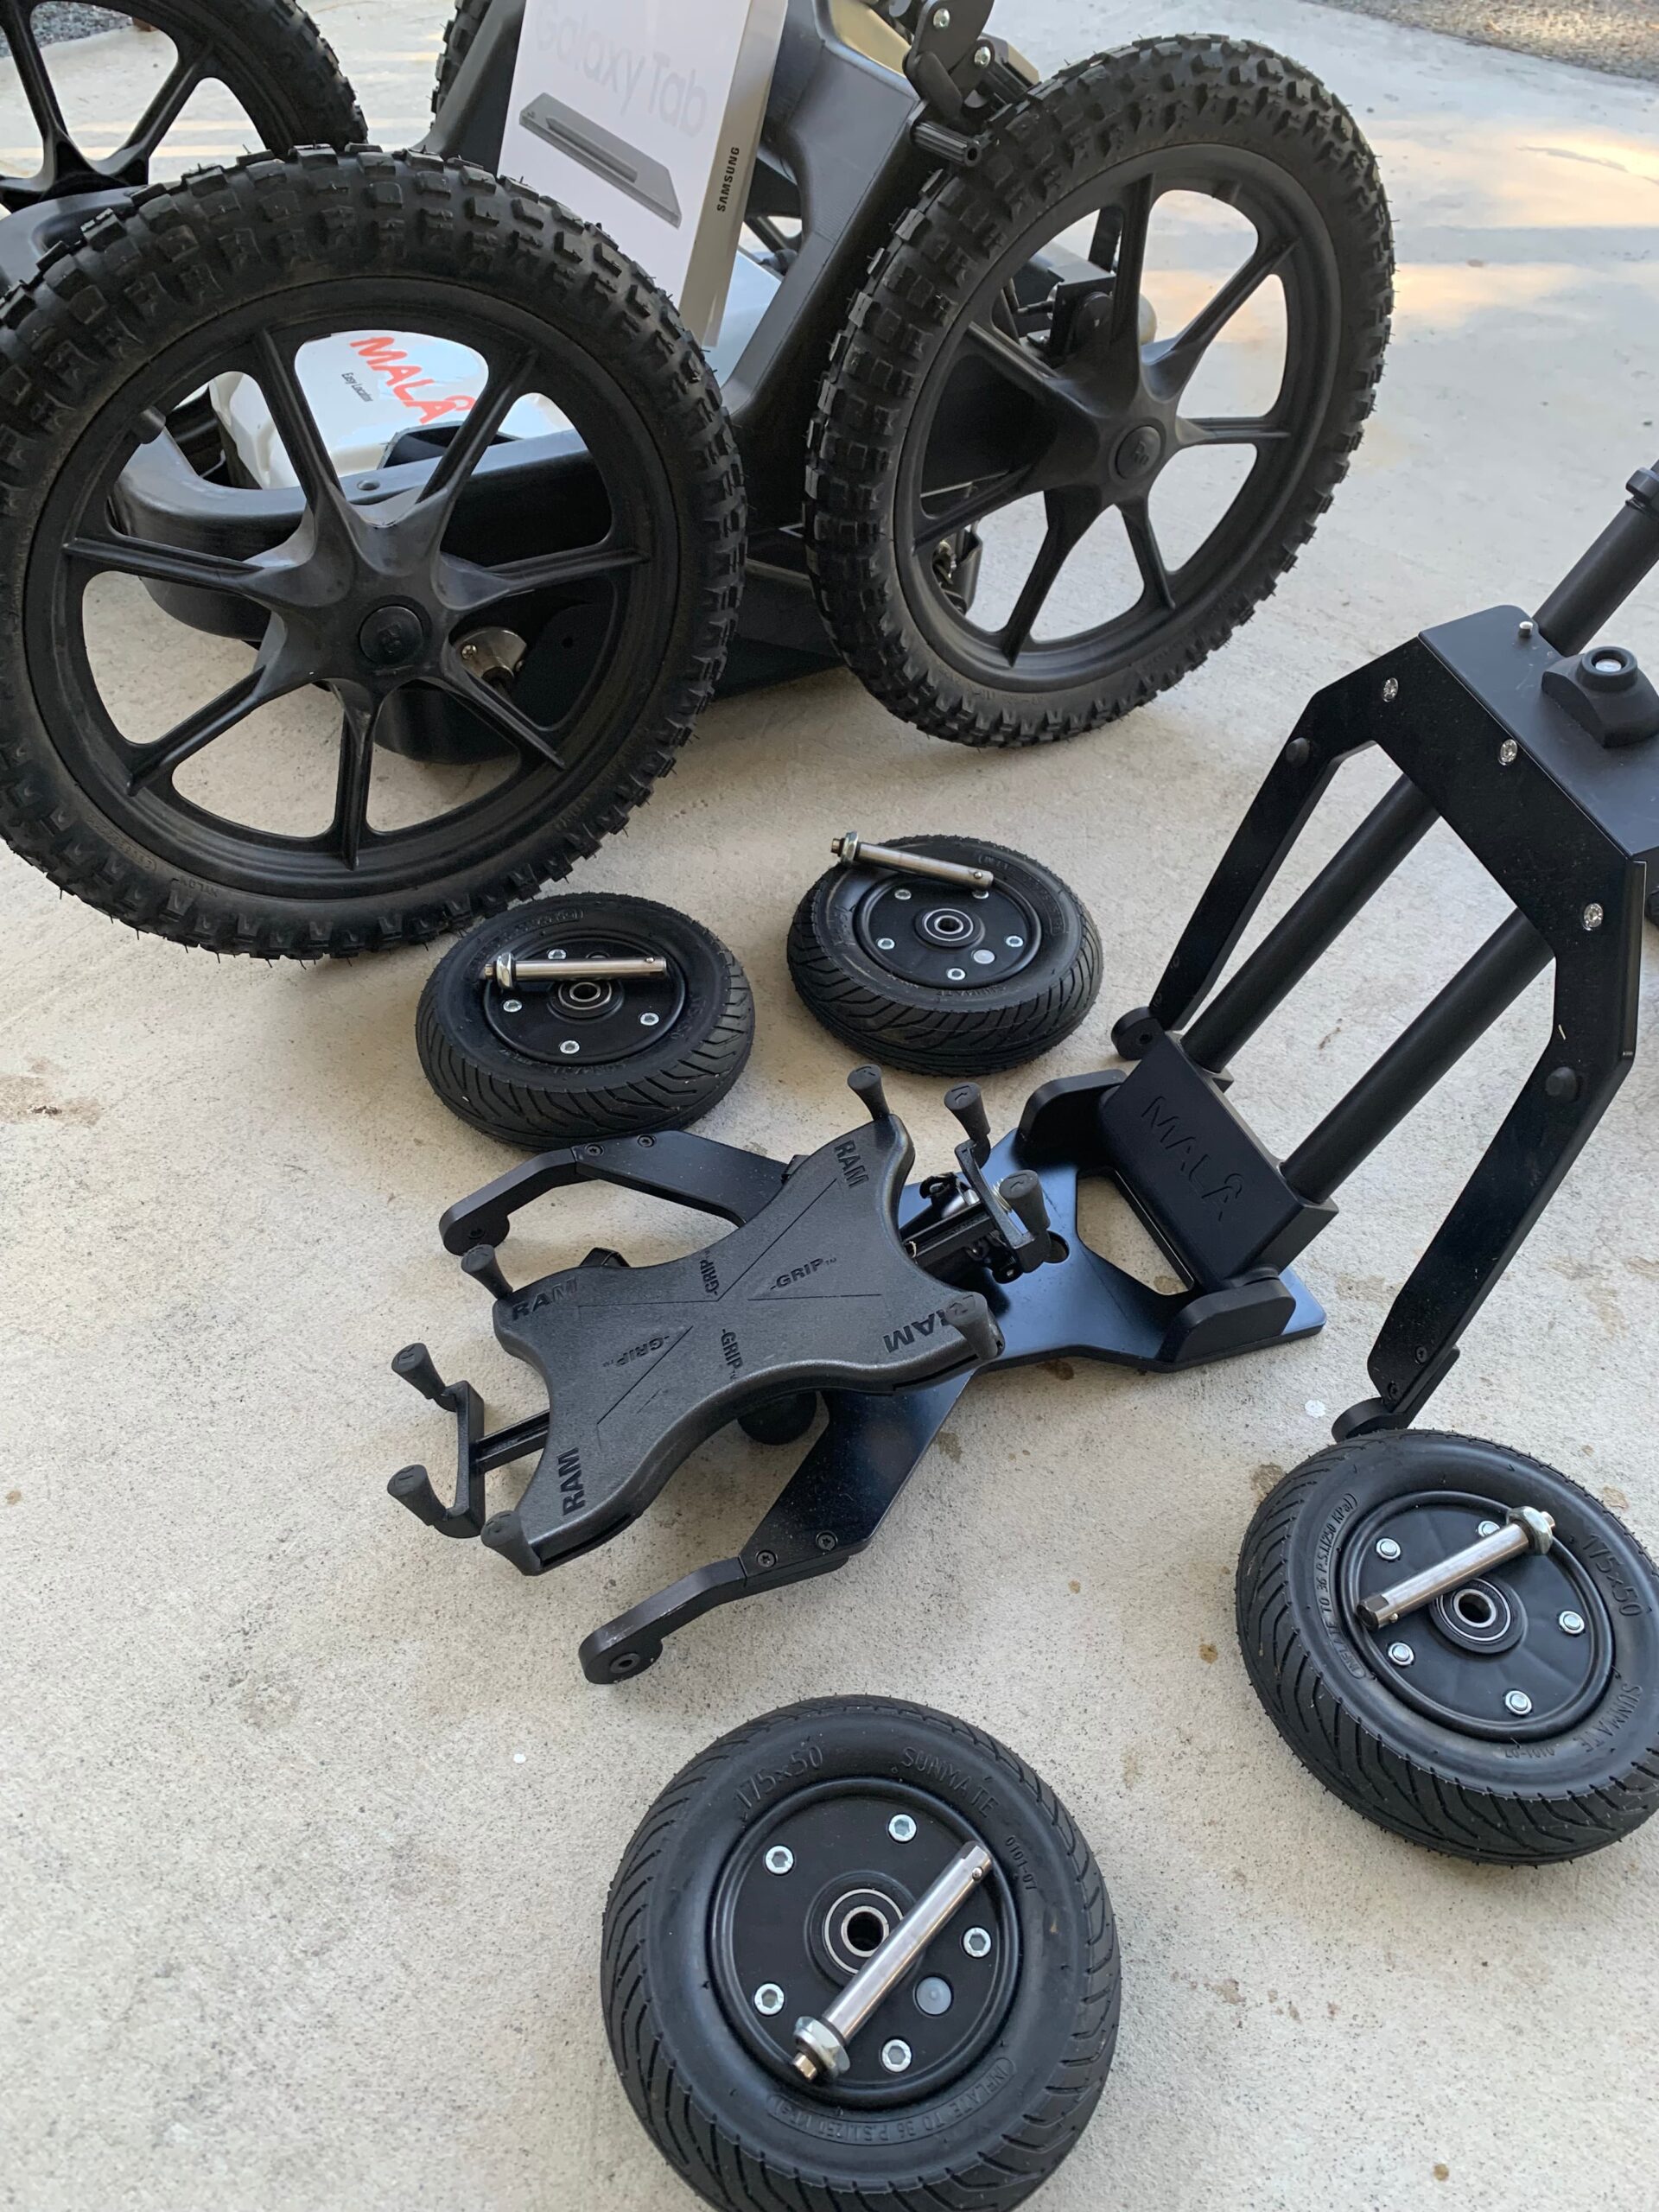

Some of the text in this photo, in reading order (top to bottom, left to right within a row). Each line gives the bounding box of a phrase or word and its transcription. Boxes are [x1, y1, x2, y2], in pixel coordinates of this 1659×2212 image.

[648, 51, 708, 137] Tab
[716, 146, 741, 213] SAMSUNG
[341, 372, 358, 385] Easy
[833, 1140, 870, 1189] RAM
[512, 1276, 578, 1321] RAM
[556, 1447, 587, 1517] RAM
[1573, 1681, 1642, 1753] SUNMATE
[900, 1745, 999, 1819] SUNMATE
[1004, 1834, 1037, 1891] 0101-07
[949, 2066, 1011, 2118] INFLATE
[922, 2111, 946, 2131] TO
